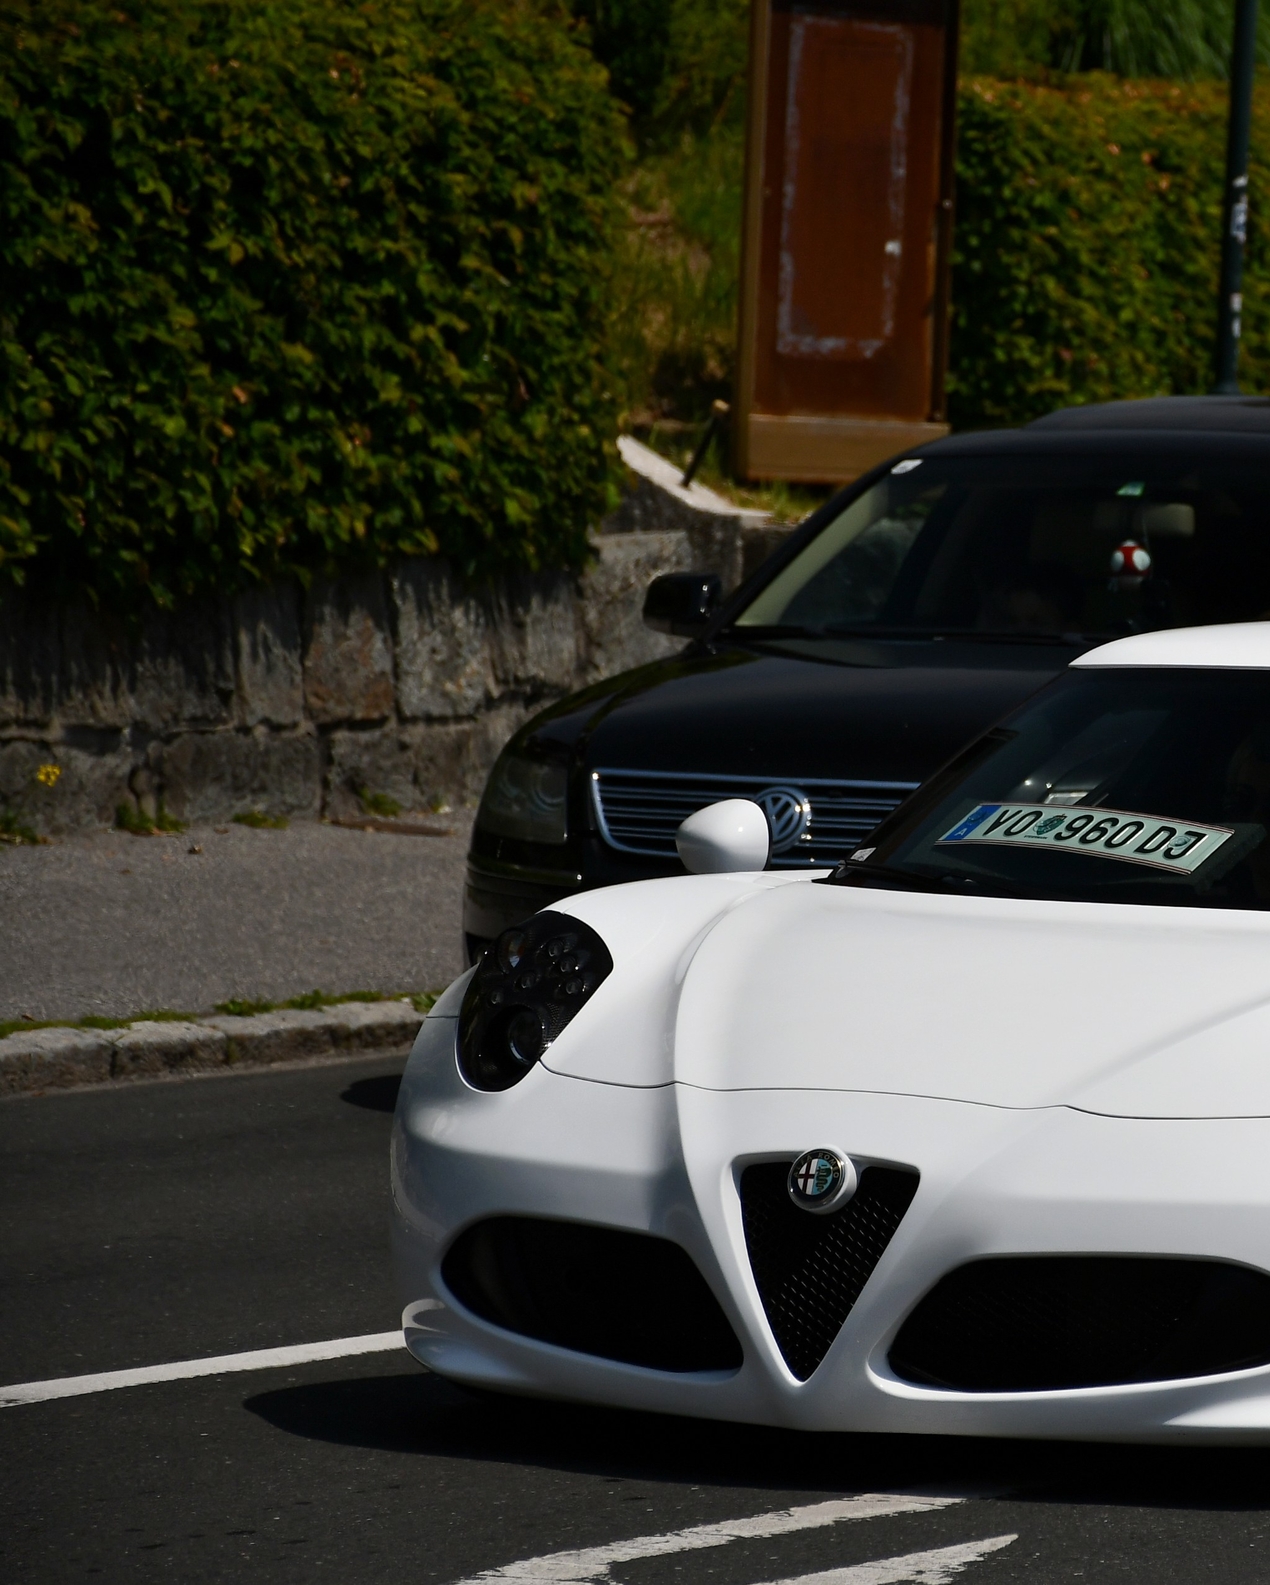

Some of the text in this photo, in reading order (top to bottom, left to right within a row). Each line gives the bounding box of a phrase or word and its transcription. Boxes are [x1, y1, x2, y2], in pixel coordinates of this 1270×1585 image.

[983, 809, 1208, 860] VO 960 DJ
[818, 1152, 840, 1178] ROMEO
